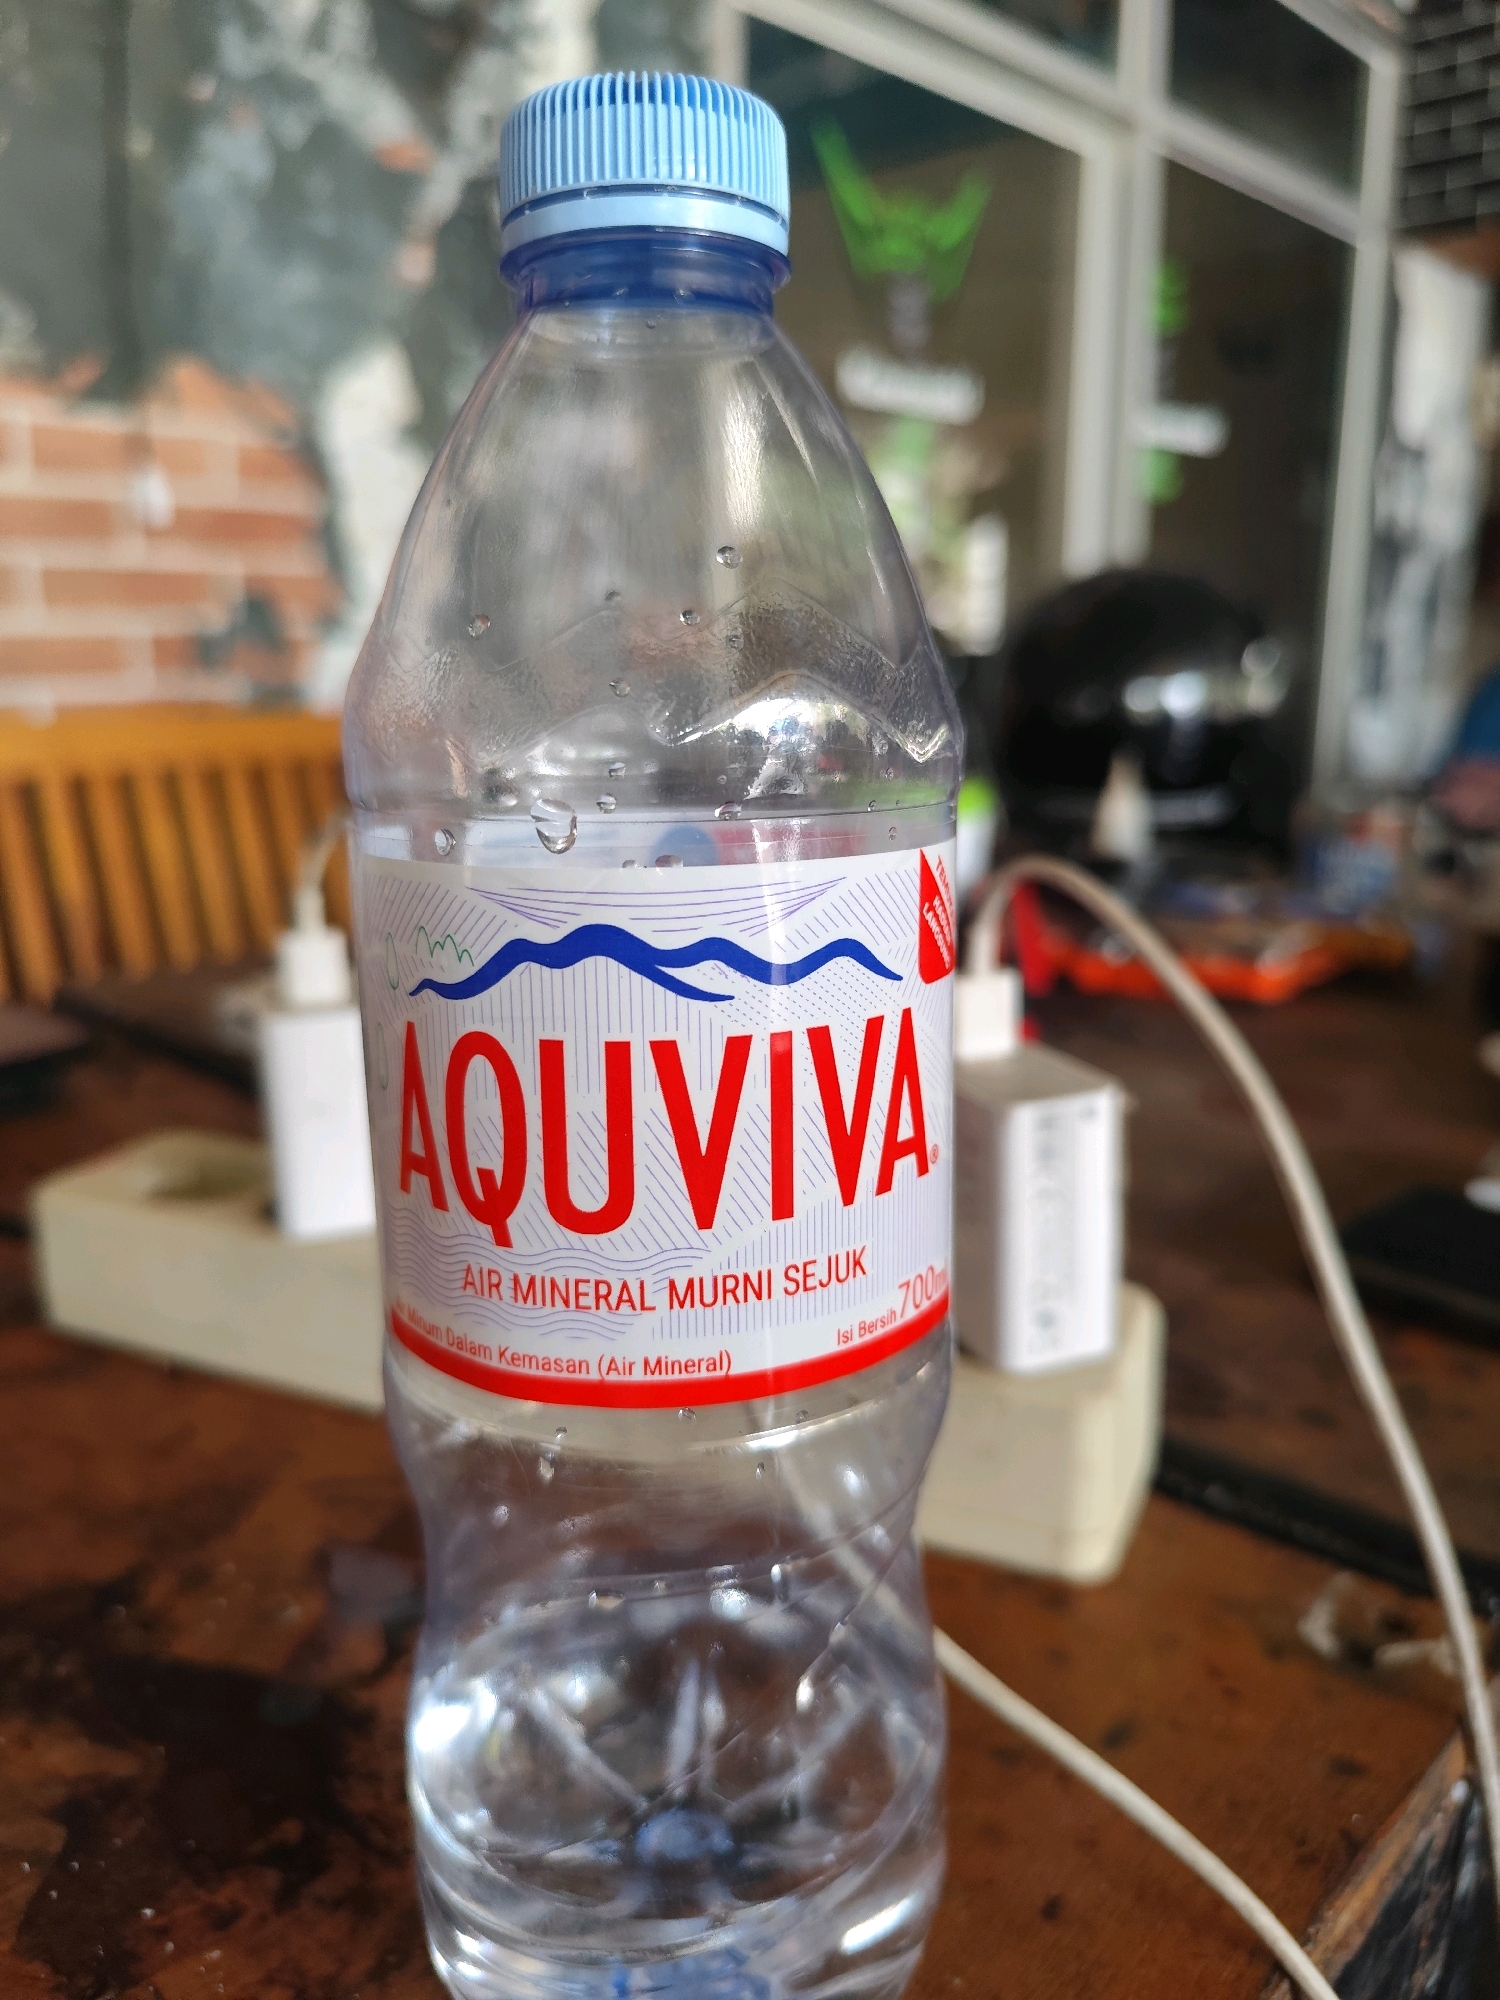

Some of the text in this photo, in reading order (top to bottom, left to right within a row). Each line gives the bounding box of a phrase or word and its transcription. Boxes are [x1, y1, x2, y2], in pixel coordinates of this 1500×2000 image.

[922, 901, 951, 970] LANGSUNG
[400, 1008, 929, 1248] AQUVIVA
[461, 1244, 867, 1312] AIR MINERAL MURNI SEJUK
[408, 1304, 443, 1342] Minum
[446, 1325, 493, 1361] Dalam
[498, 1345, 590, 1375] Kemasan
[598, 1353, 636, 1380] (Air
[643, 1349, 732, 1378] Mineral)
[837, 1323, 853, 1346] Isi
[858, 1306, 897, 1339] Bersih
